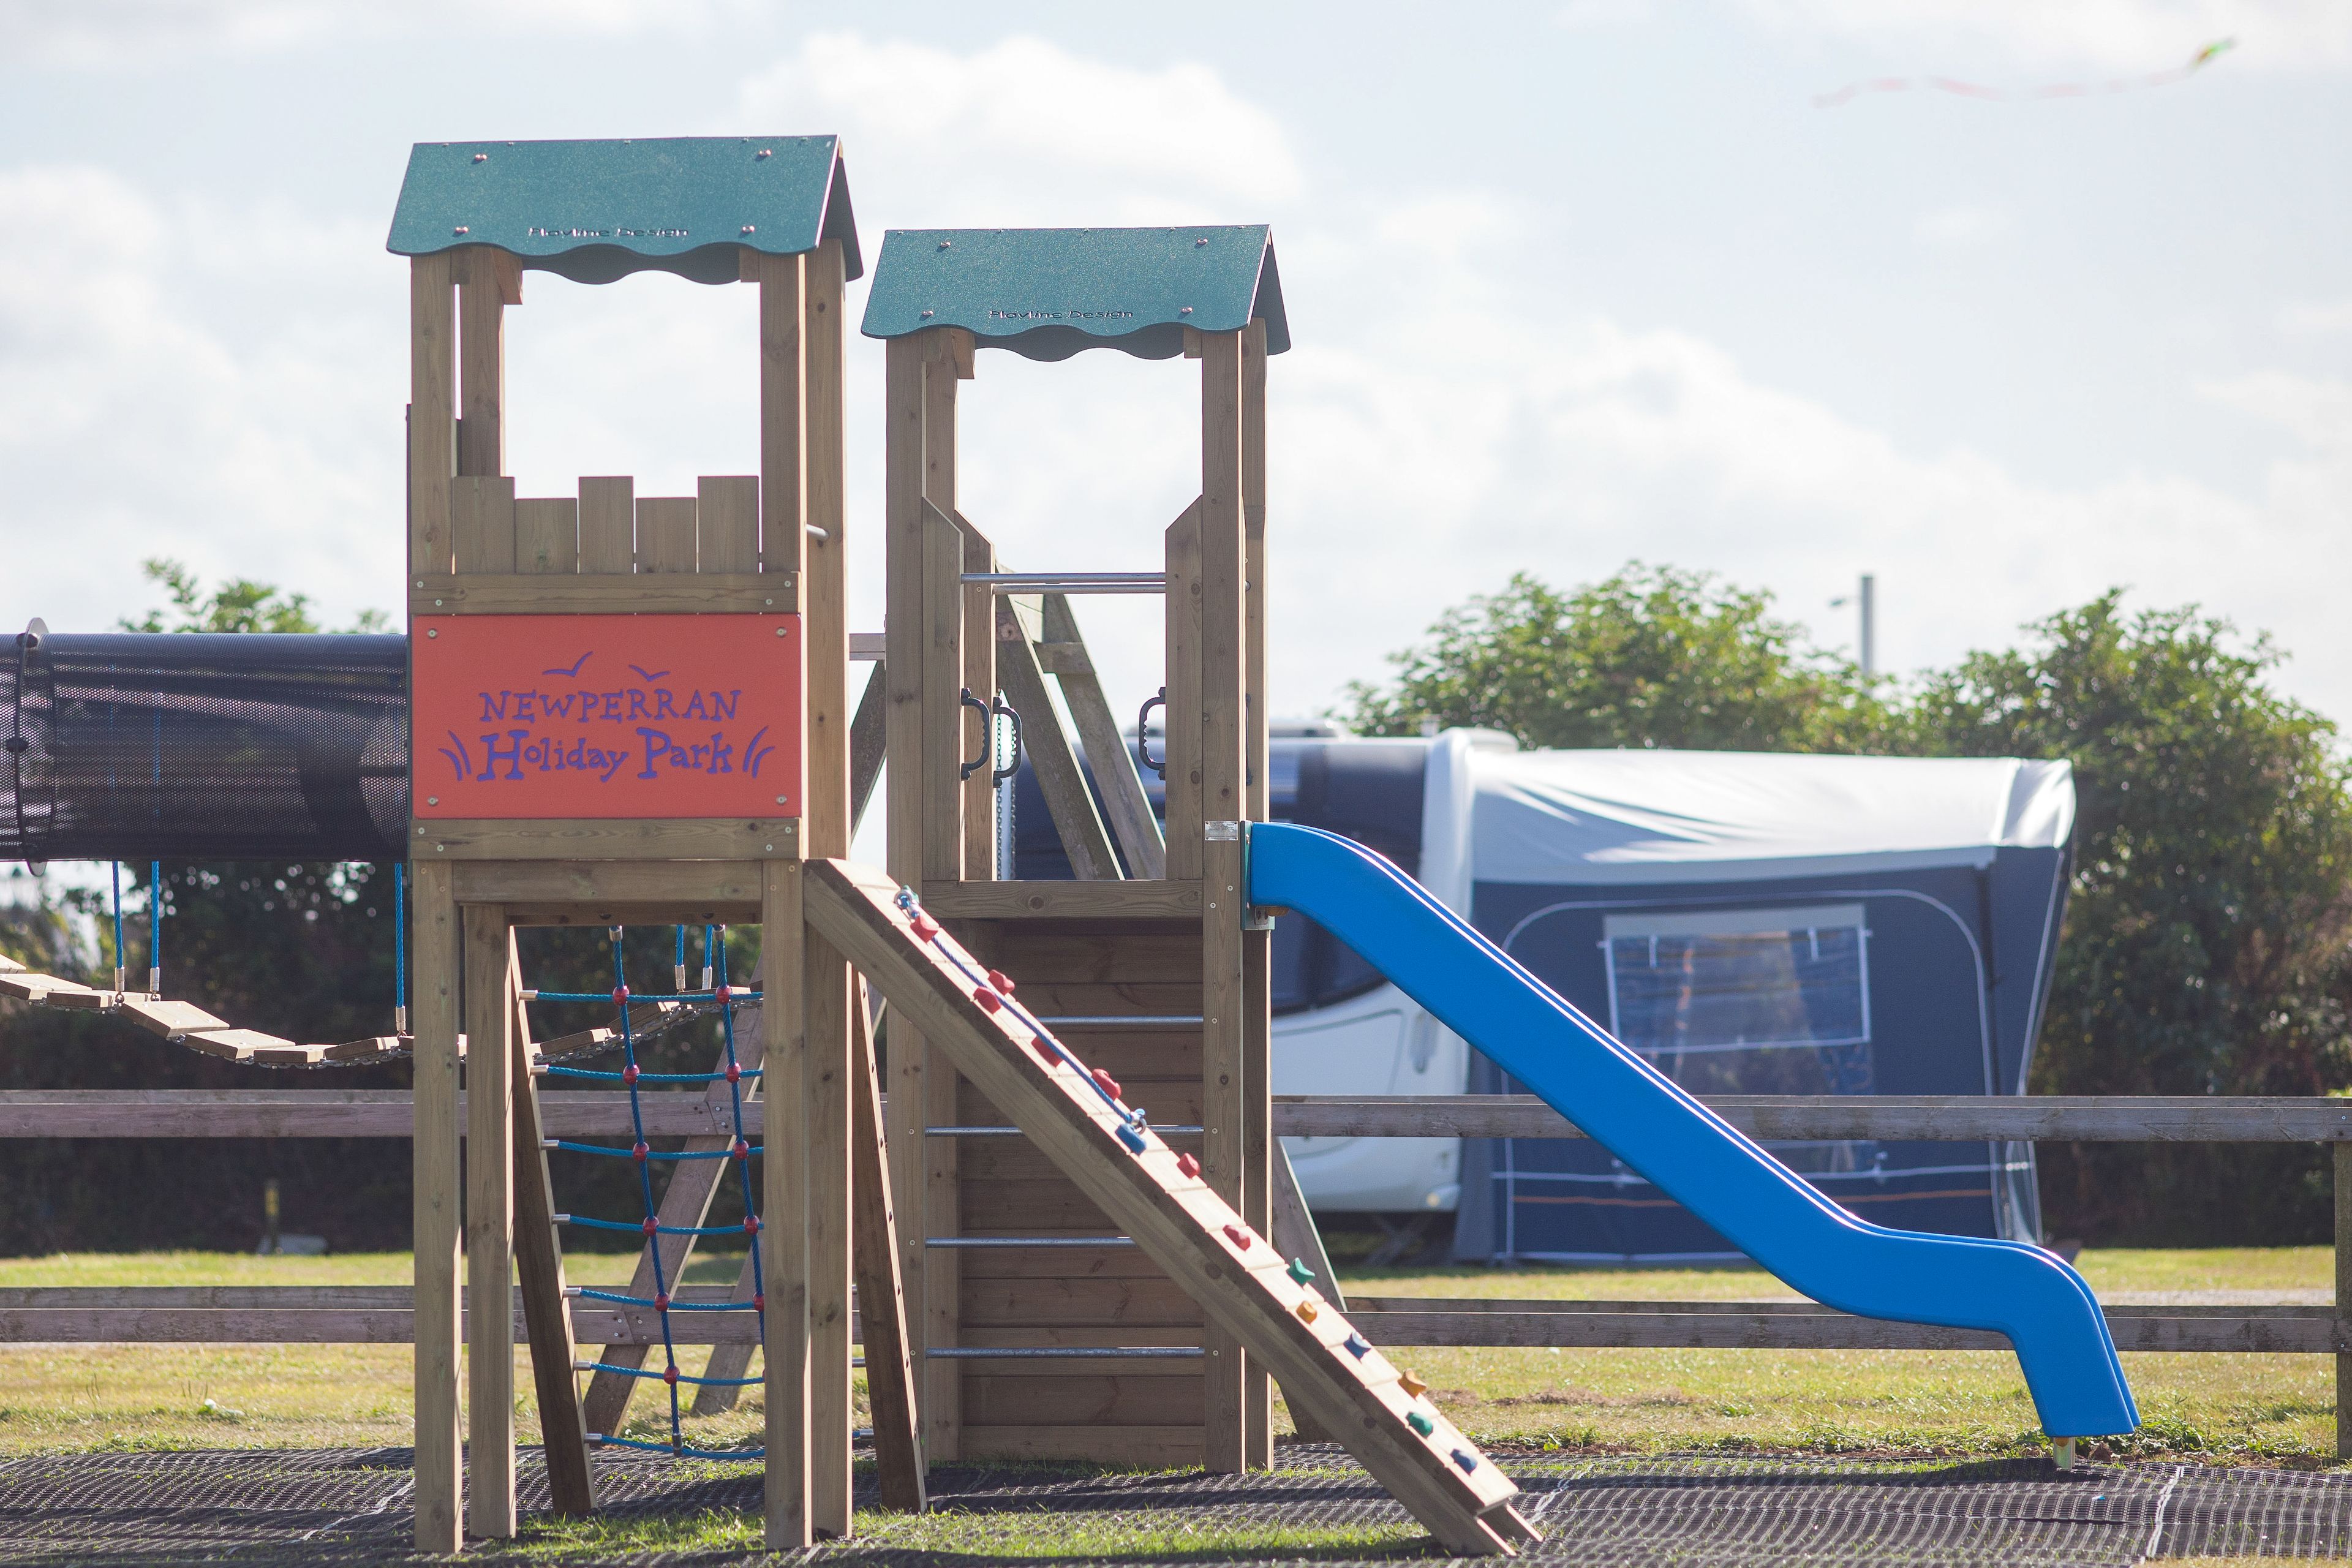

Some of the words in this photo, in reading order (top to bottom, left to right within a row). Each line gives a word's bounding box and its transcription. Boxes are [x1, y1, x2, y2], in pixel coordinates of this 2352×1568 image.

[614, 227, 689, 238] Design
[989, 310, 1063, 320] Playline
[1066, 310, 1133, 319] Design
[478, 689, 742, 723] NEWPERRAN
[476, 729, 629, 783] Holiday
[636, 726, 734, 780] Park
